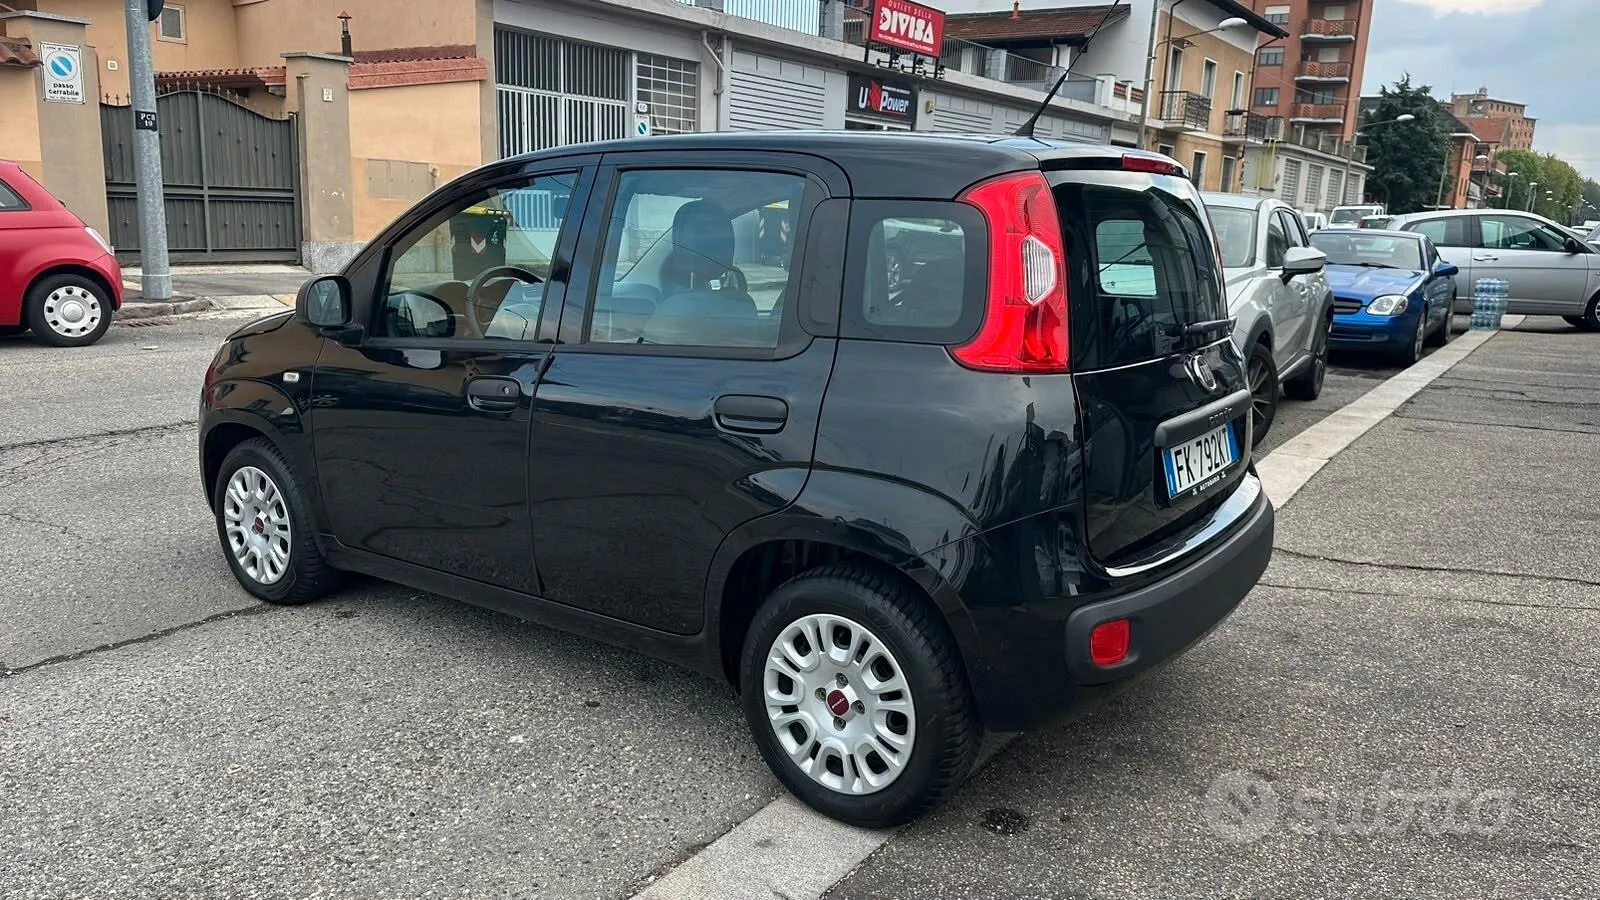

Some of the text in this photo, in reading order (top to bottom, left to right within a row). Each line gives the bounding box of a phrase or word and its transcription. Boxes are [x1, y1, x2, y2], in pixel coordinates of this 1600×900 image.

[888, 0, 932, 19] OUTLET DELLA
[879, 6, 934, 45] DIVISA
[880, 91, 908, 112] Power
